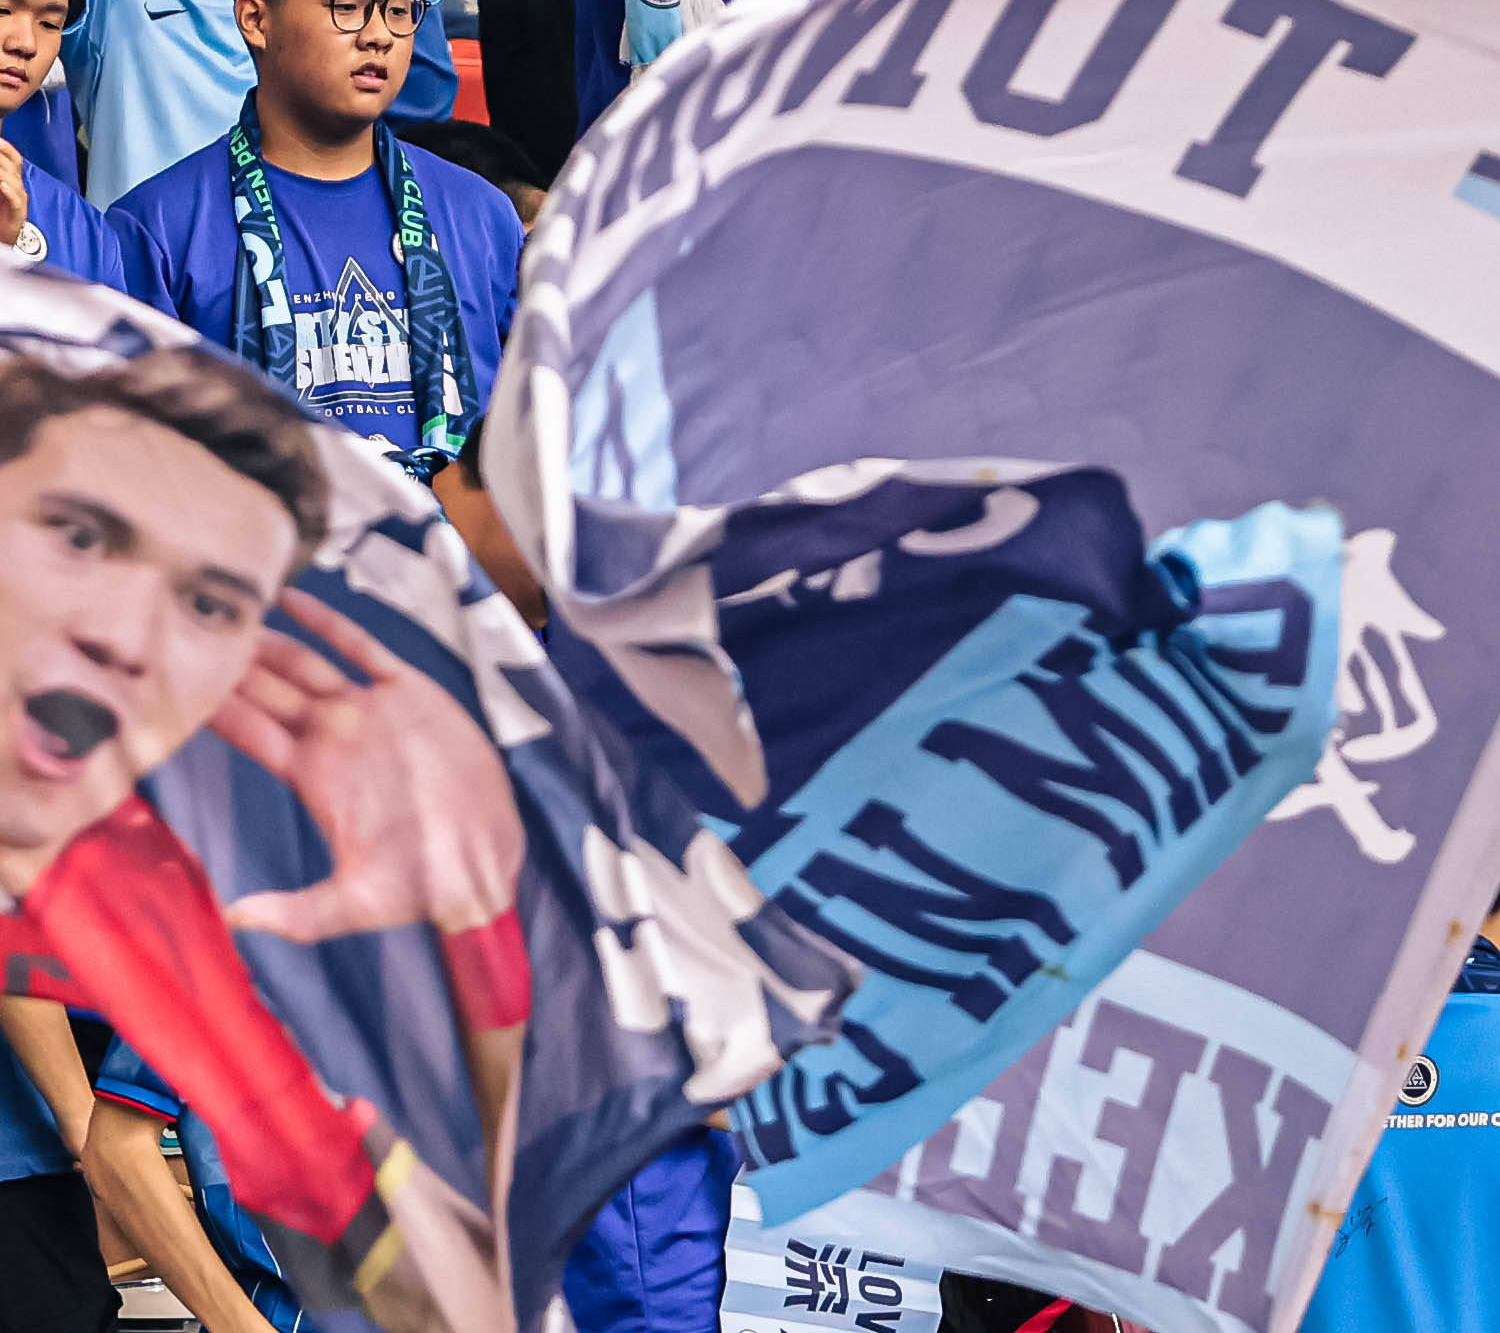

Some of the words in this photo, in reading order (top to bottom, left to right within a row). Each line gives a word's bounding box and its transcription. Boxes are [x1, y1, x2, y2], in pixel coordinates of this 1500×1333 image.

[402, 179, 424, 248] CLUB
[325, 402, 390, 418] OOTBALL
[1426, 1114, 1455, 1128] FOR
[1457, 1112, 1488, 1127] OUR
[859, 1250, 903, 1333] LOV
